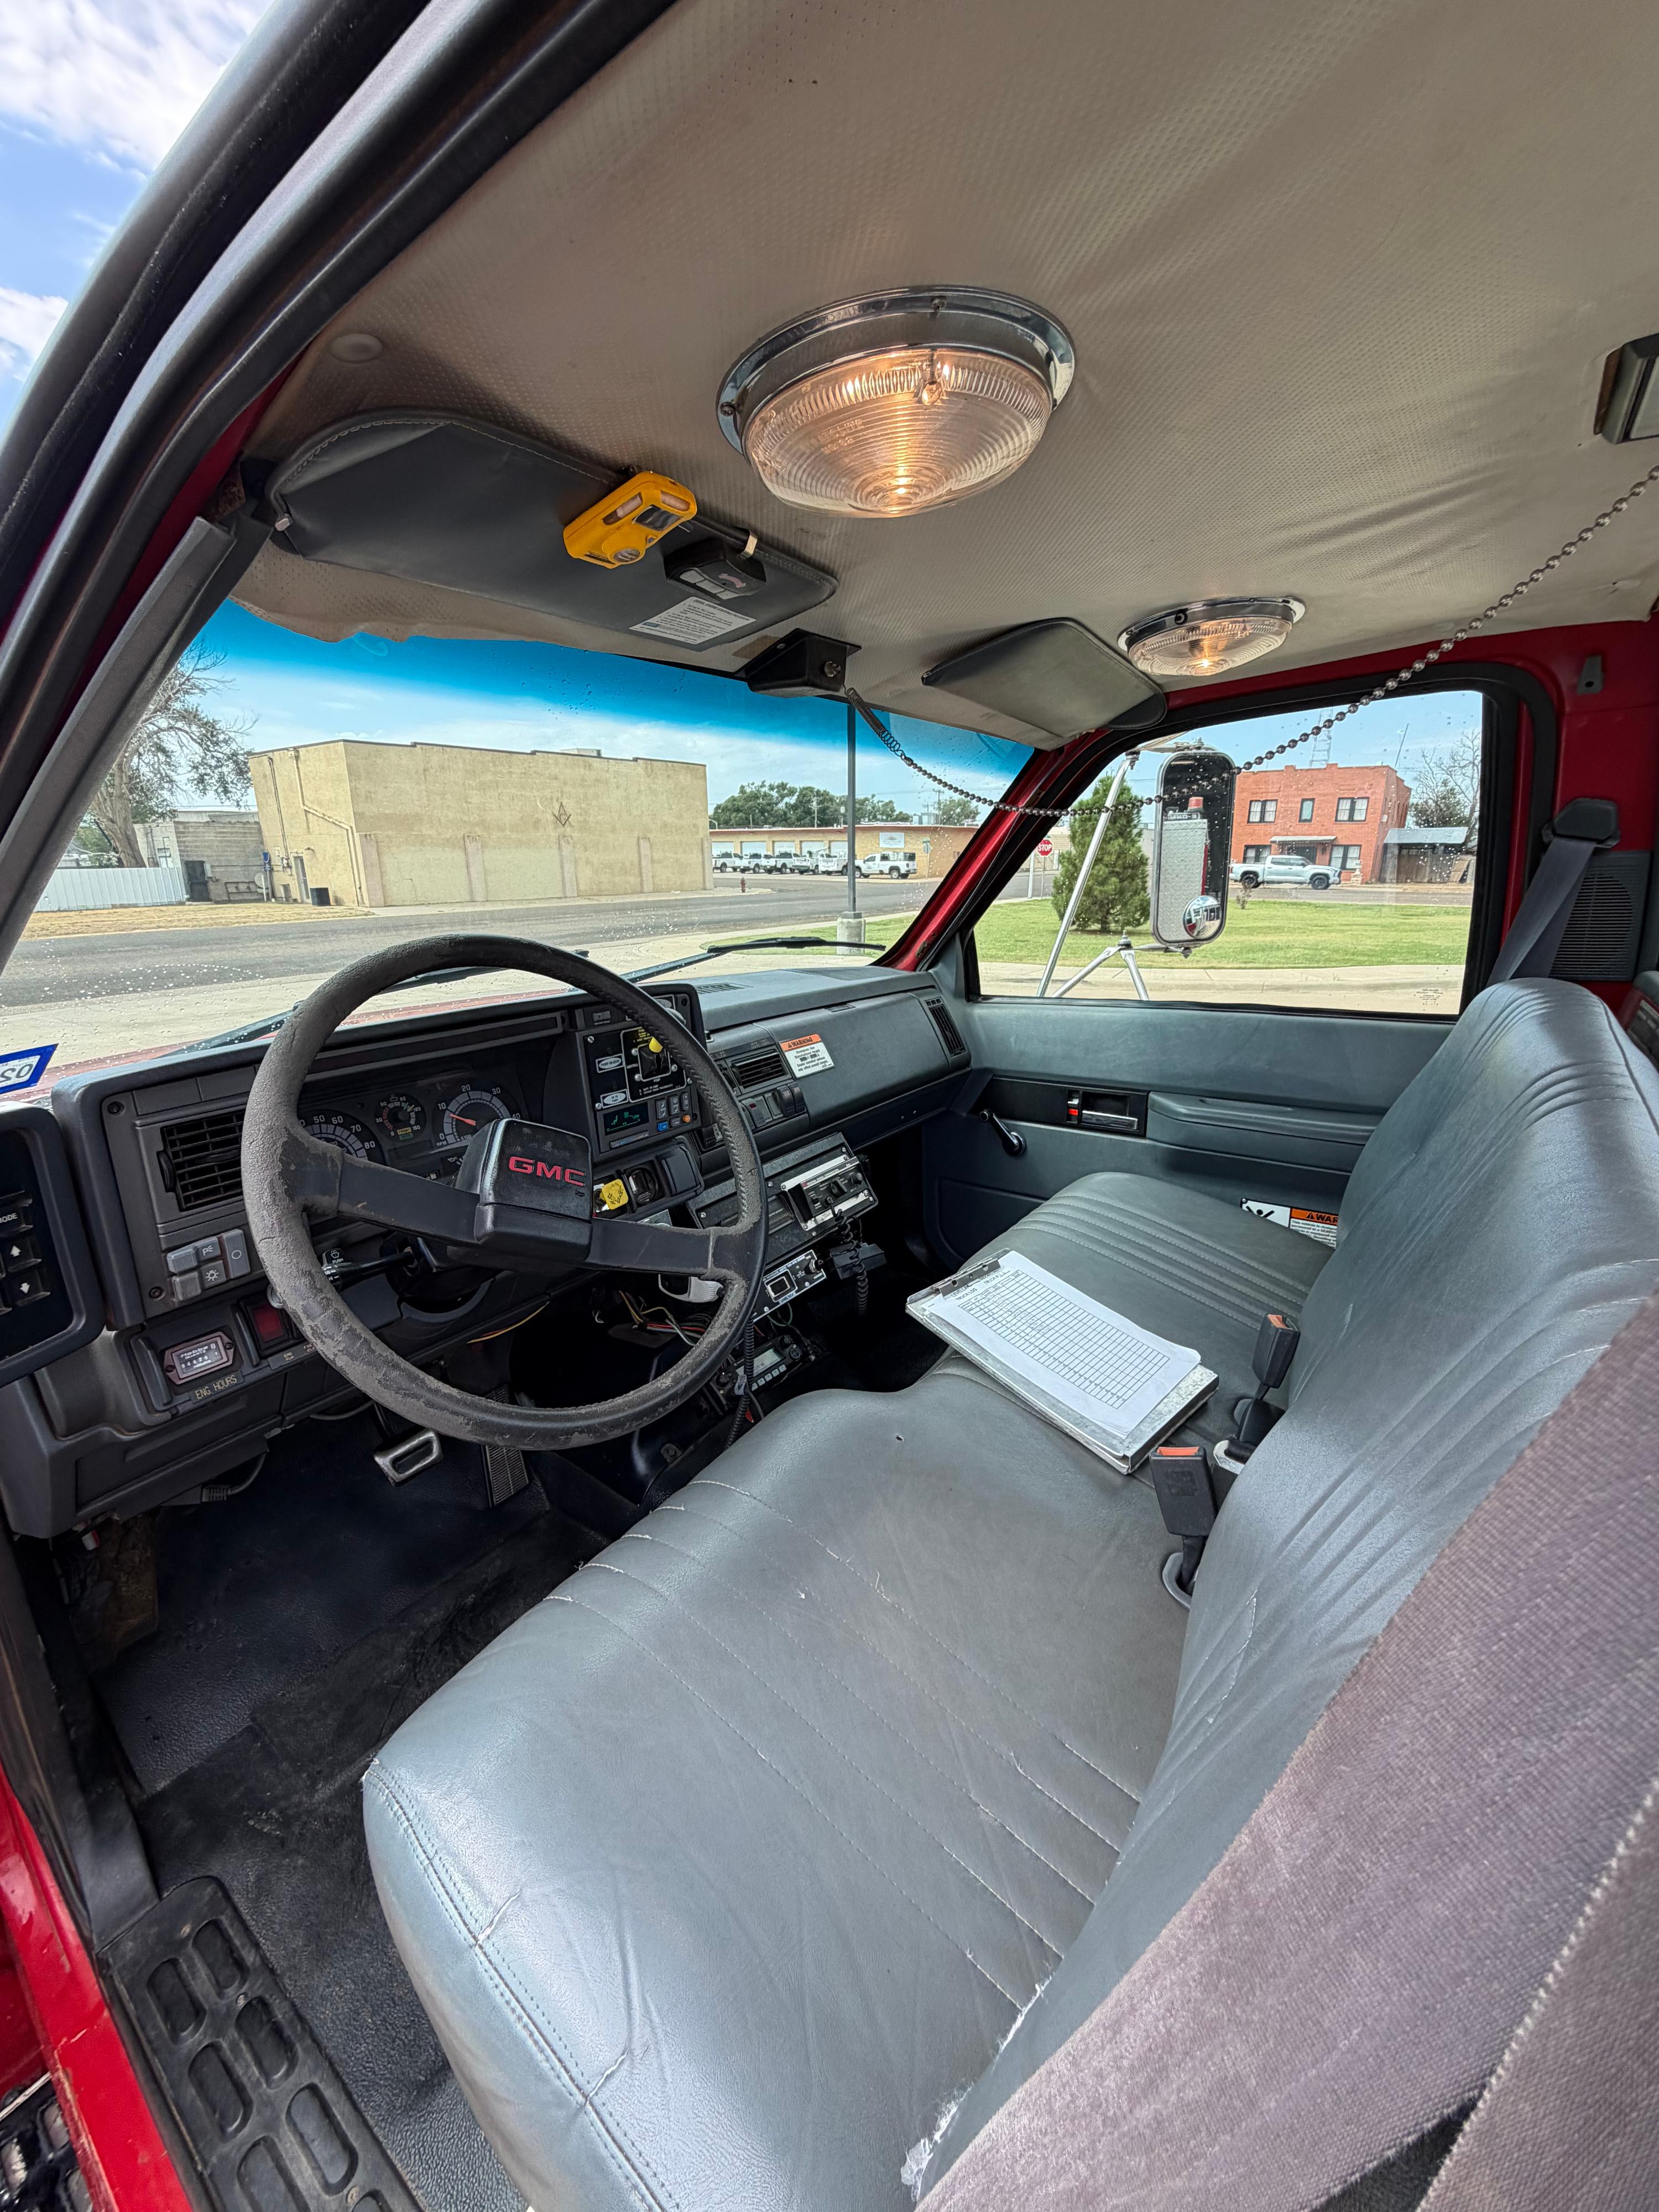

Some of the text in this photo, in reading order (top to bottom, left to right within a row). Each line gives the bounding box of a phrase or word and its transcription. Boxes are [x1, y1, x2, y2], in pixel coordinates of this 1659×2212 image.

[791, 1037, 813, 1047] WARNING
[313, 1115, 325, 1123] 50
[332, 1116, 343, 1124] 60
[350, 1124, 362, 1133] 70
[364, 1140, 376, 1149] 80
[509, 1156, 586, 1186] GMC
[213, 1375, 237, 1391] HOURS
